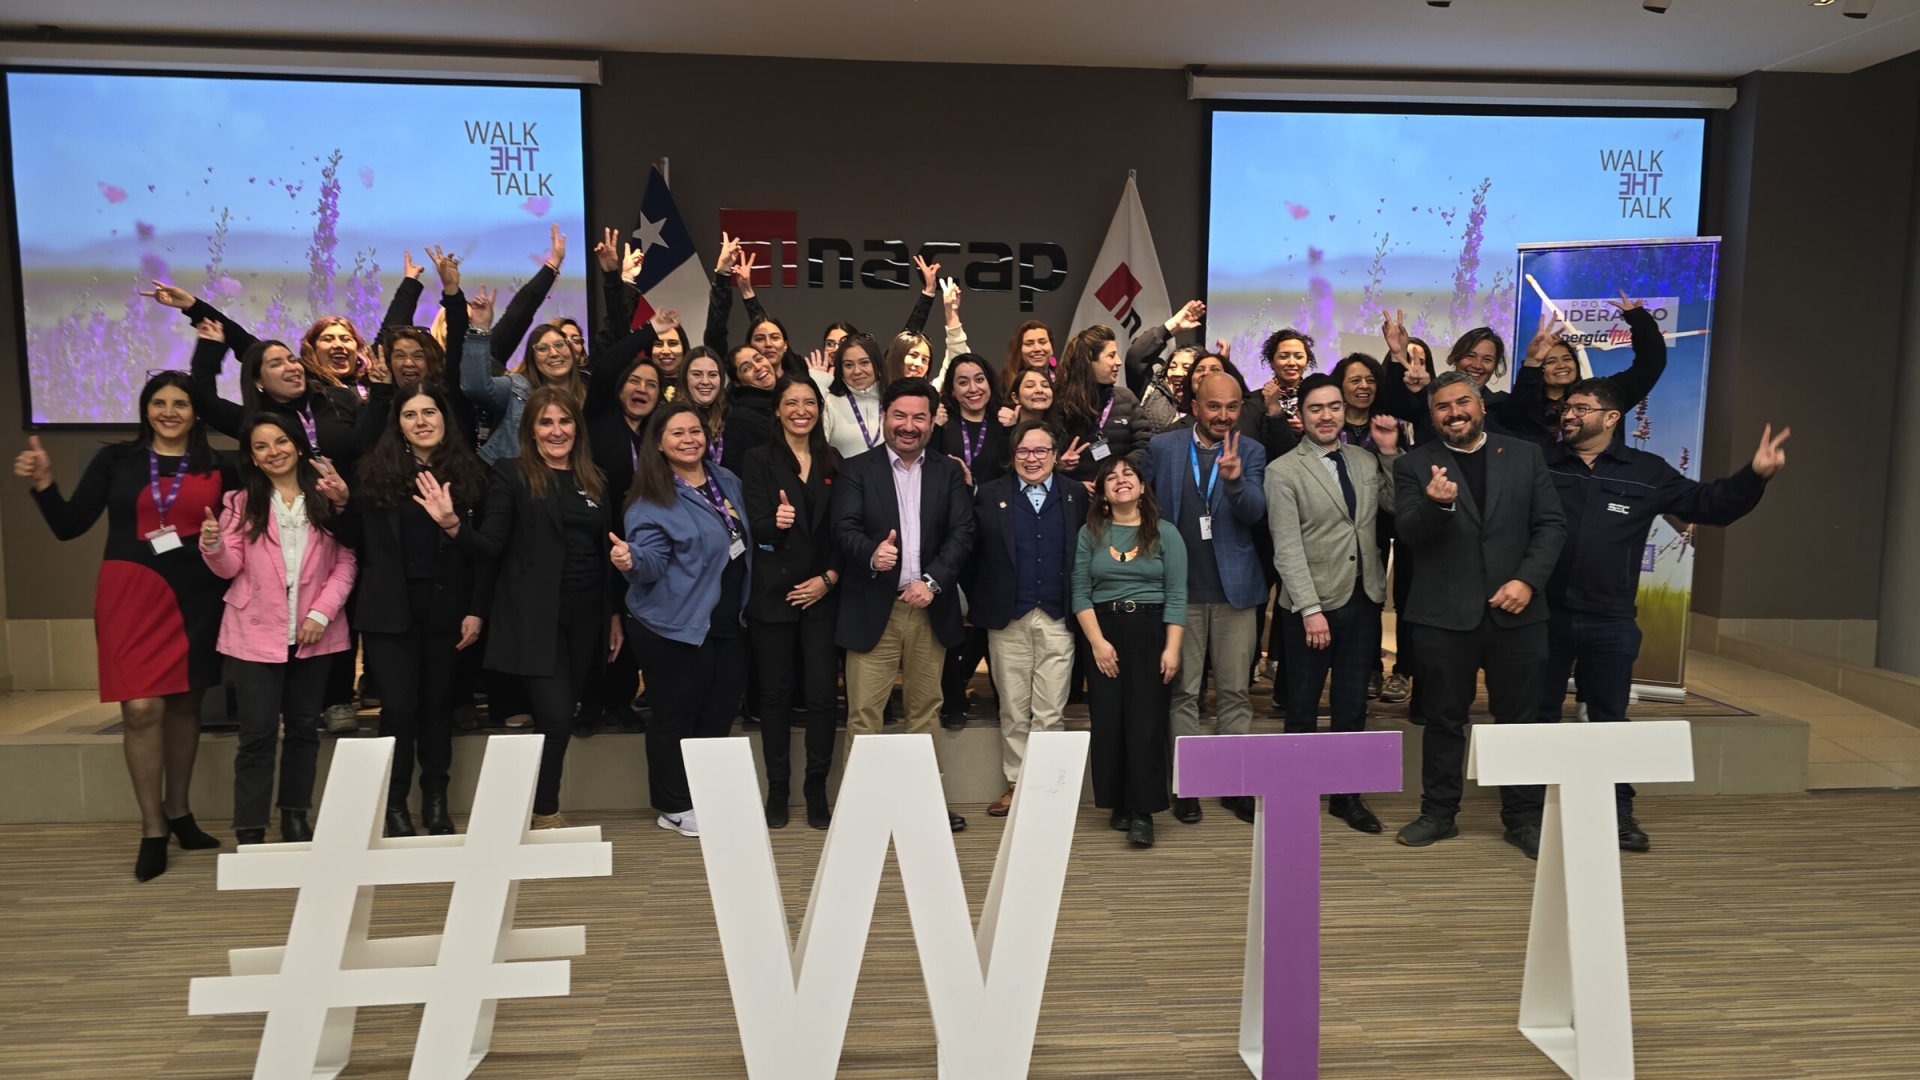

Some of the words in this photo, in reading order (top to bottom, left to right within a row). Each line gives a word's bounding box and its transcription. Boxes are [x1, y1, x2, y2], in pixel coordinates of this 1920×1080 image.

[464, 120, 539, 146] WALK
[1600, 149, 1664, 172] WALK
[490, 172, 554, 197] TALK
[1618, 197, 1672, 219] TALK
[1553, 308, 1668, 322] LIDERAO
